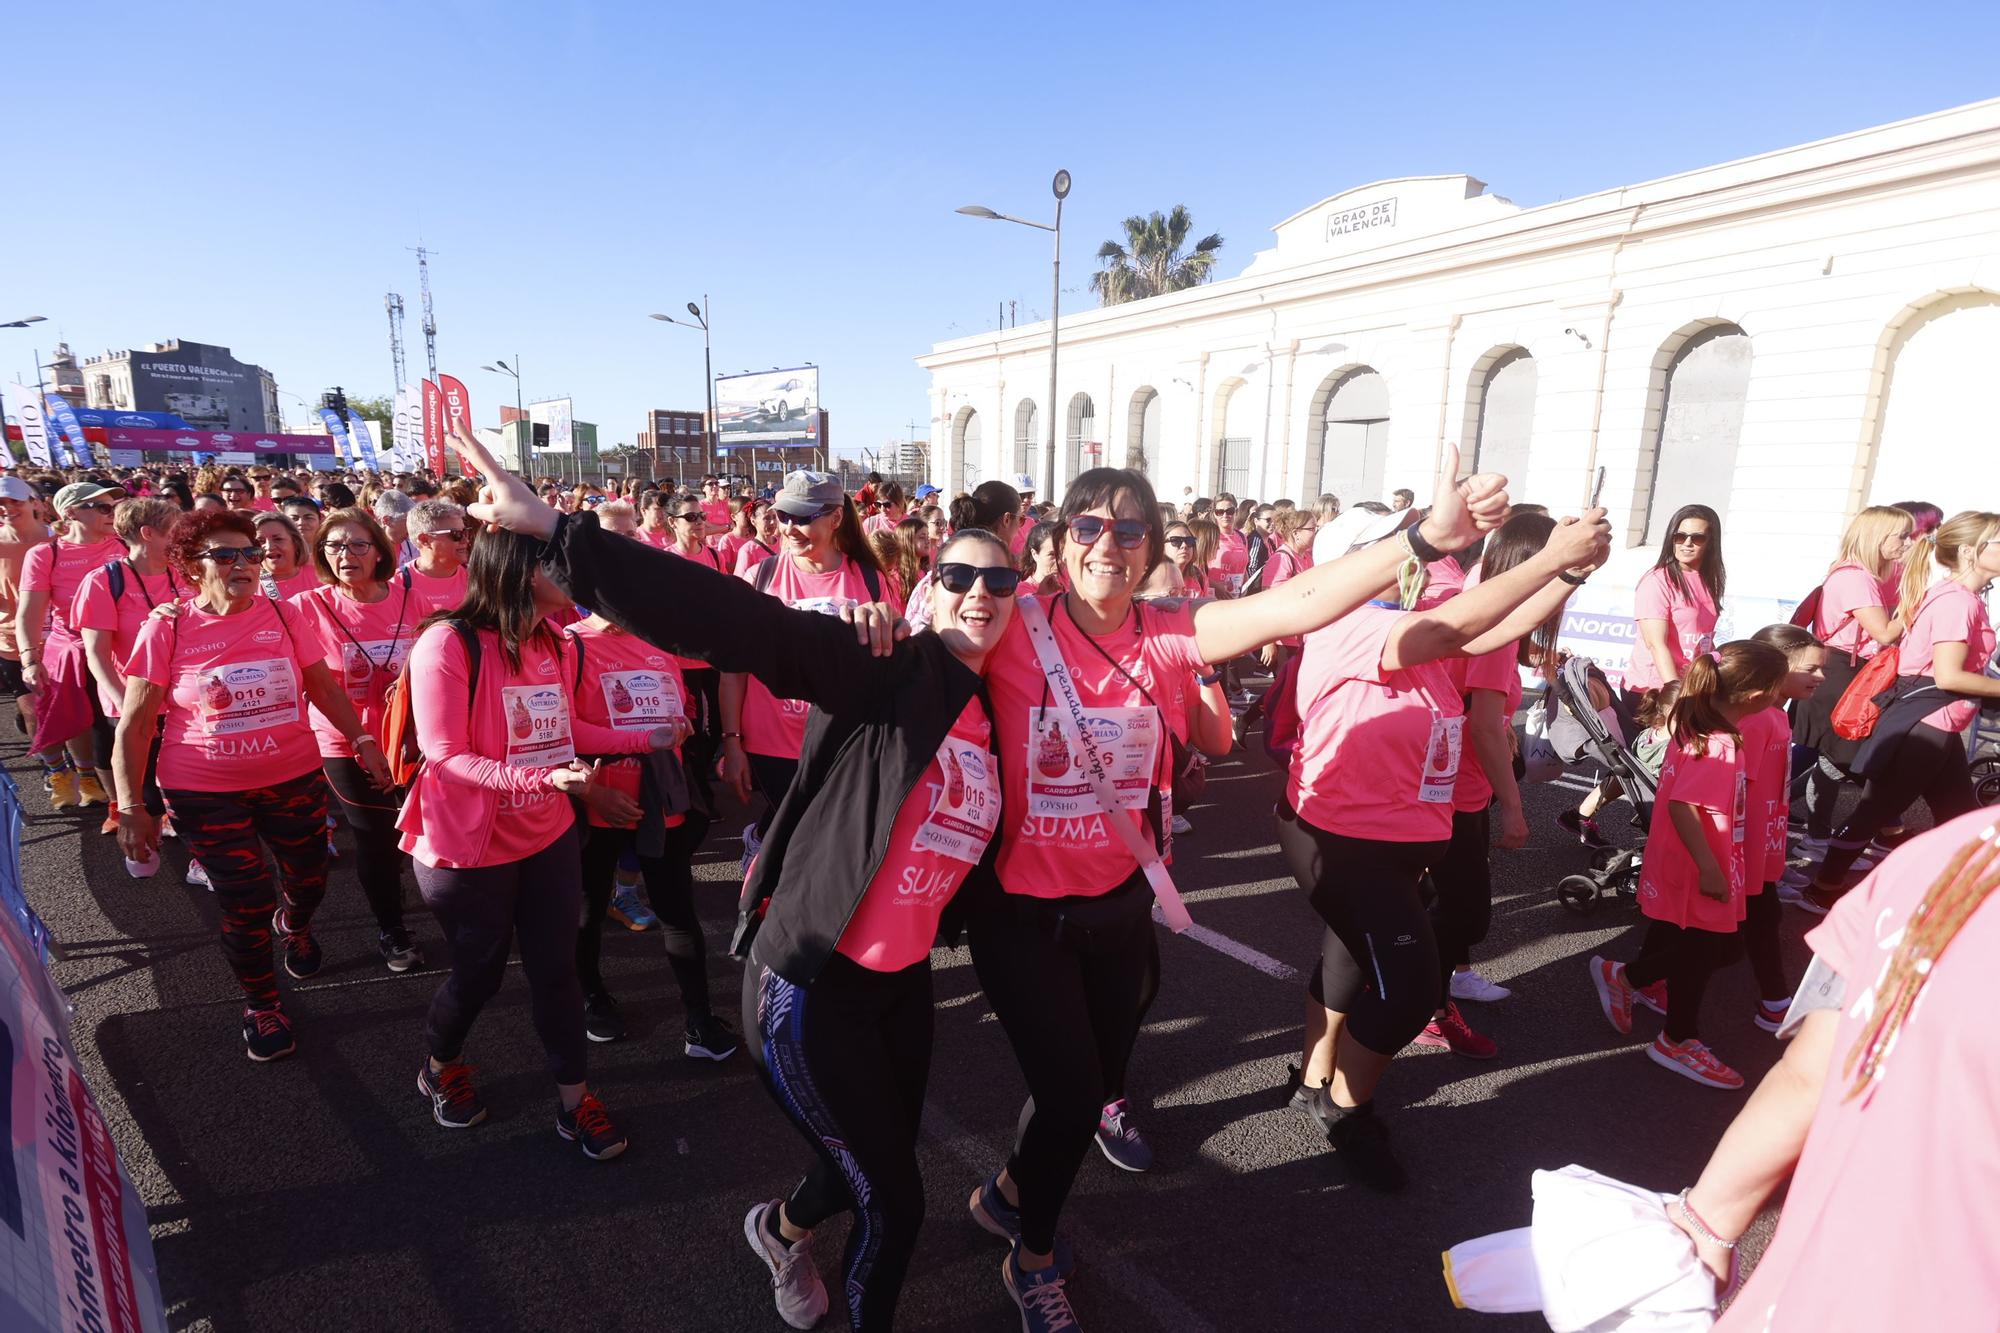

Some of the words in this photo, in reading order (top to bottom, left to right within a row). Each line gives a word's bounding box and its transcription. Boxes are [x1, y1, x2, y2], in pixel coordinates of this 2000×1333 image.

[1334, 210, 1365, 225] GRAO
[1373, 203, 1390, 215] DE
[1331, 214, 1391, 237] VALENCIA
[152, 363, 187, 373] PUERTO
[185, 641, 226, 655] OYSHO
[229, 673, 264, 682] ASTURIANA
[235, 687, 266, 700] 016
[242, 700, 260, 708] 4121
[635, 696, 660, 706] 016
[534, 716, 557, 731] 016
[1127, 721, 1150, 730] SUMA
[205, 734, 278, 755] SUMA
[965, 785, 985, 807] 016
[1044, 786, 1078, 794] CARRERA
[1040, 800, 1078, 811] OYSHO
[966, 808, 981, 820] 4124
[942, 818, 965, 830] CARRERA
[1020, 815, 1107, 841] SUMA
[930, 831, 961, 849] OYSHO
[898, 865, 956, 897] SUMA
[59, 1167, 80, 1195] a
